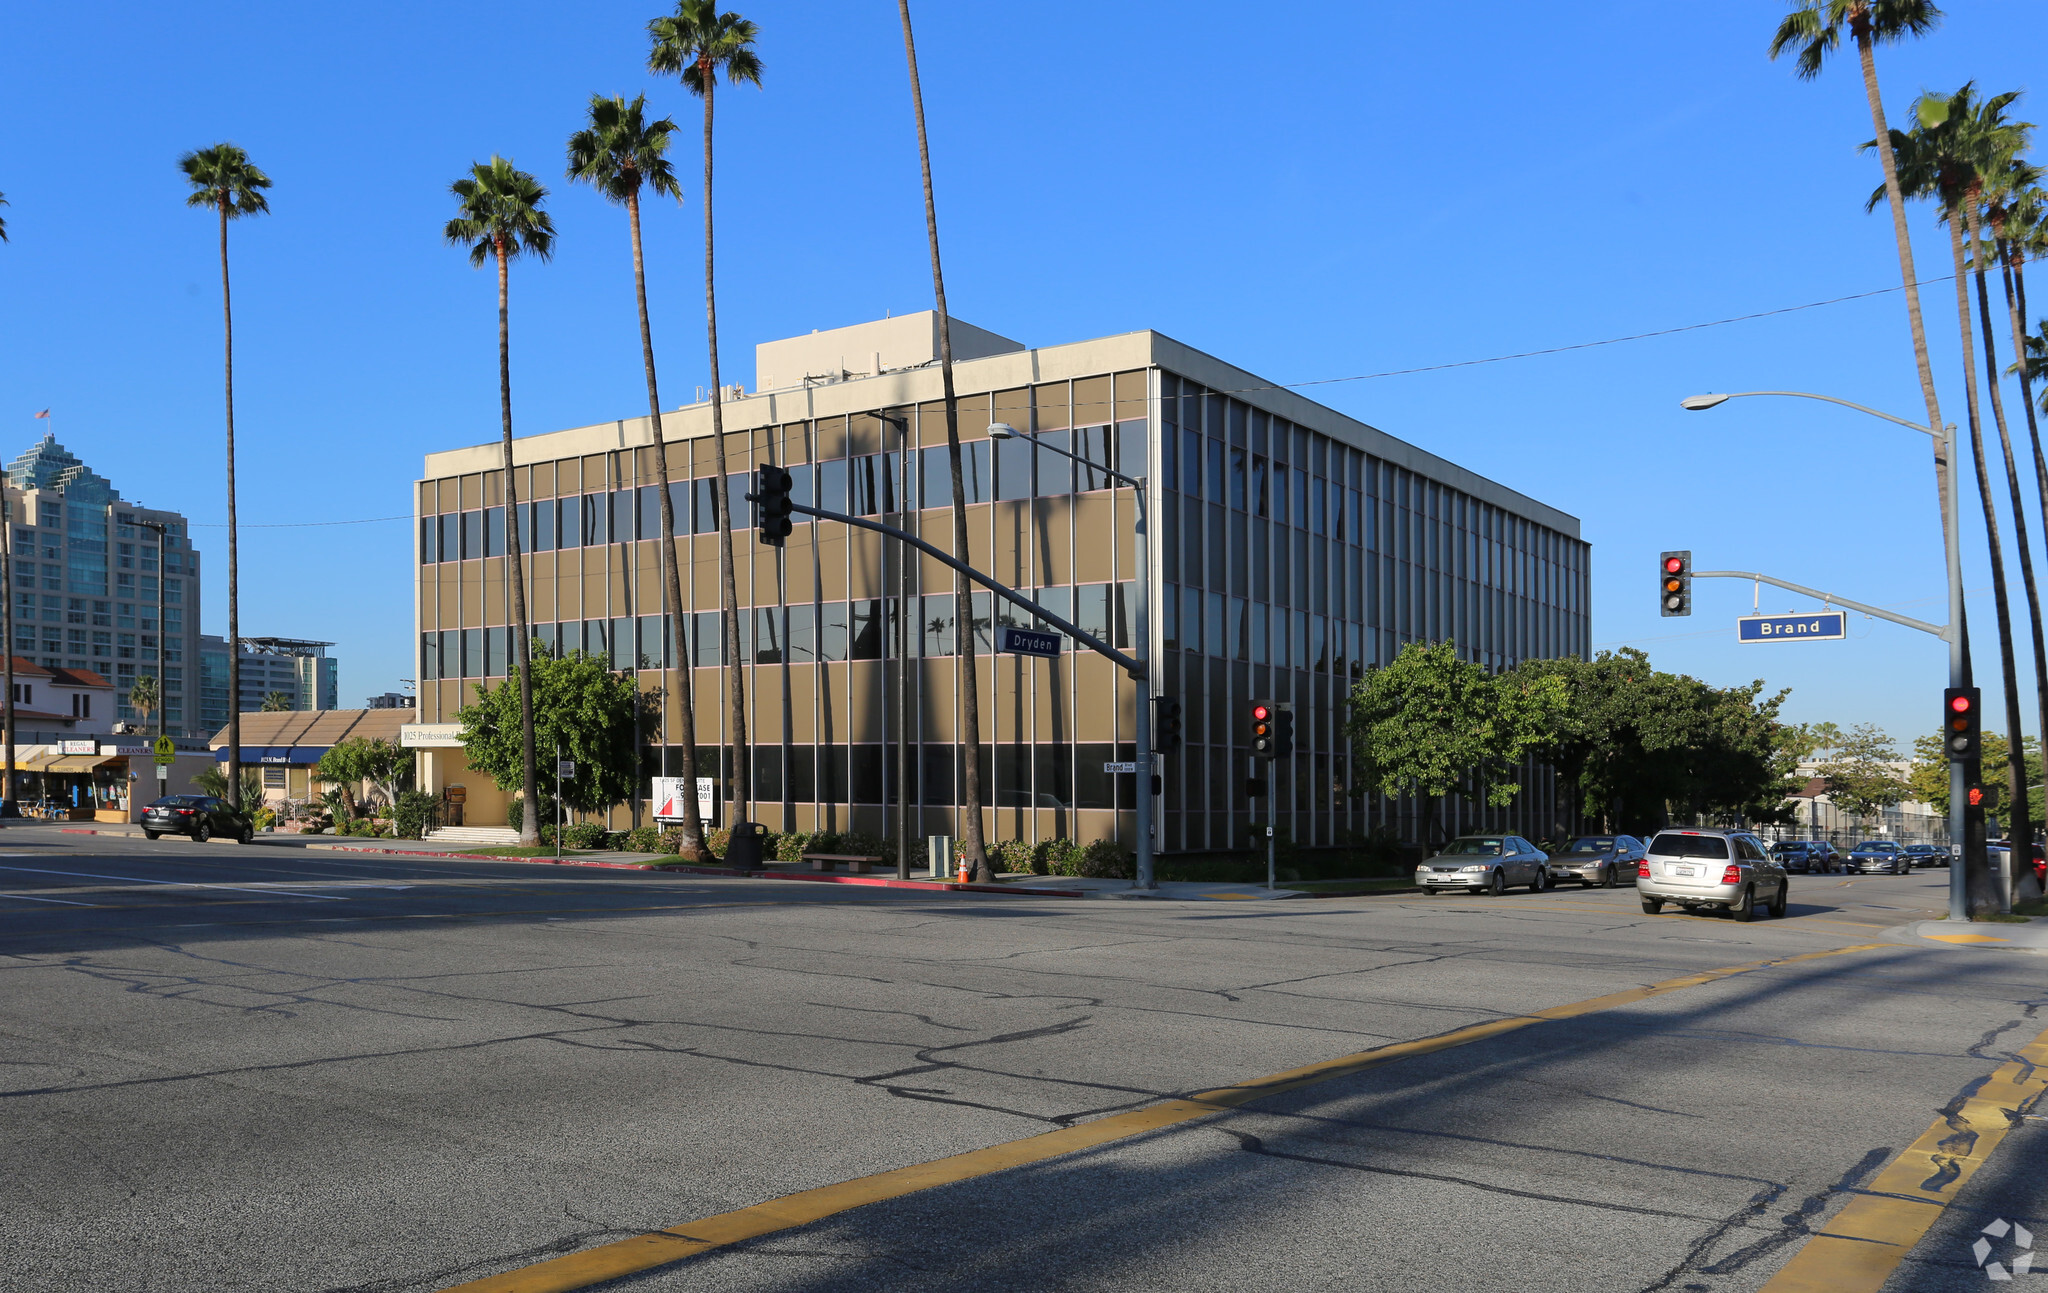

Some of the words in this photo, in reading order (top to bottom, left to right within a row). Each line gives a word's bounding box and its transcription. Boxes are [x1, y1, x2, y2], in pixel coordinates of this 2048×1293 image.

[1761, 620, 1819, 635] Brand
[1014, 634, 1052, 651] Dryden
[418, 731, 454, 740] Professional
[1106, 763, 1123, 771] Brand
